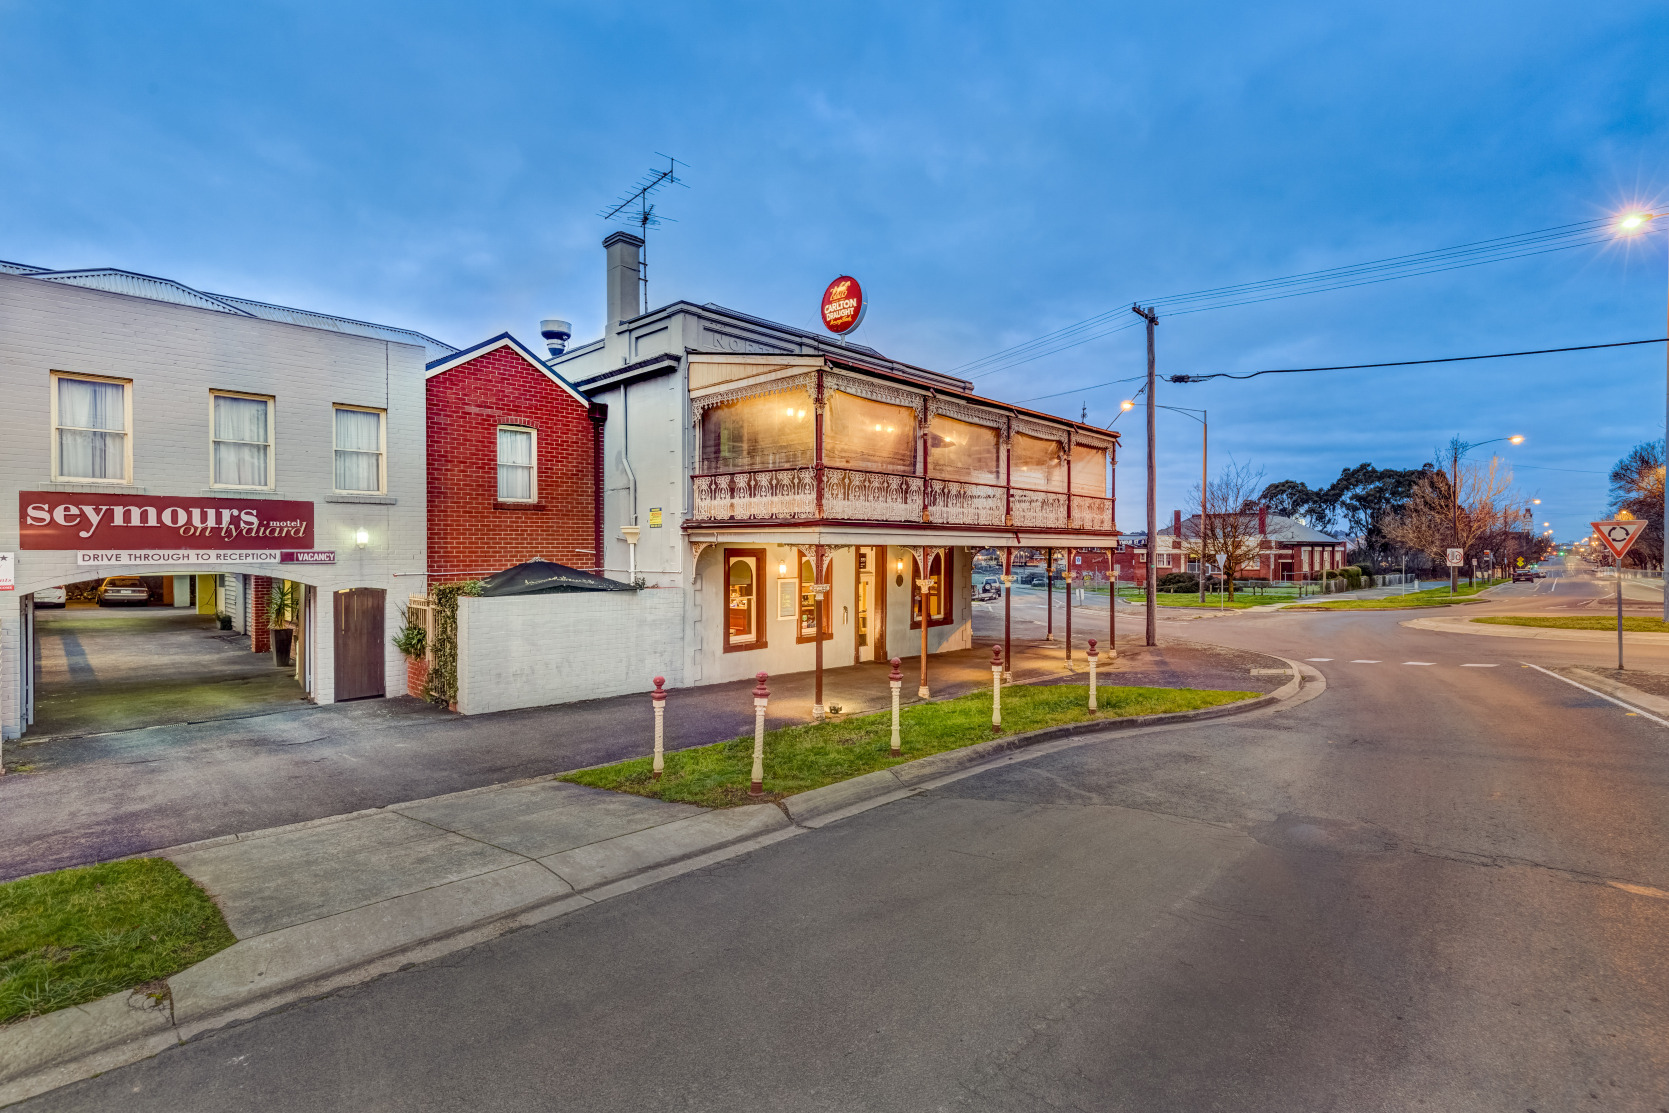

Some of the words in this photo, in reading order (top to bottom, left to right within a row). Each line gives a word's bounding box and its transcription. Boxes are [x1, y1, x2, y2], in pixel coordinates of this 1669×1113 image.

[824, 298, 857, 314] CARLTON
[826, 307, 855, 321] DRAUGHT
[26, 503, 258, 538] seymours
[269, 519, 301, 527] motel
[179, 525, 212, 537] on
[221, 520, 308, 542] lydiard
[82, 553, 122, 562] DRIVE
[127, 553, 190, 562] THROUGH
[195, 553, 211, 561] TO
[216, 552, 277, 561] RECEPTION
[297, 552, 335, 562] VACANCY
